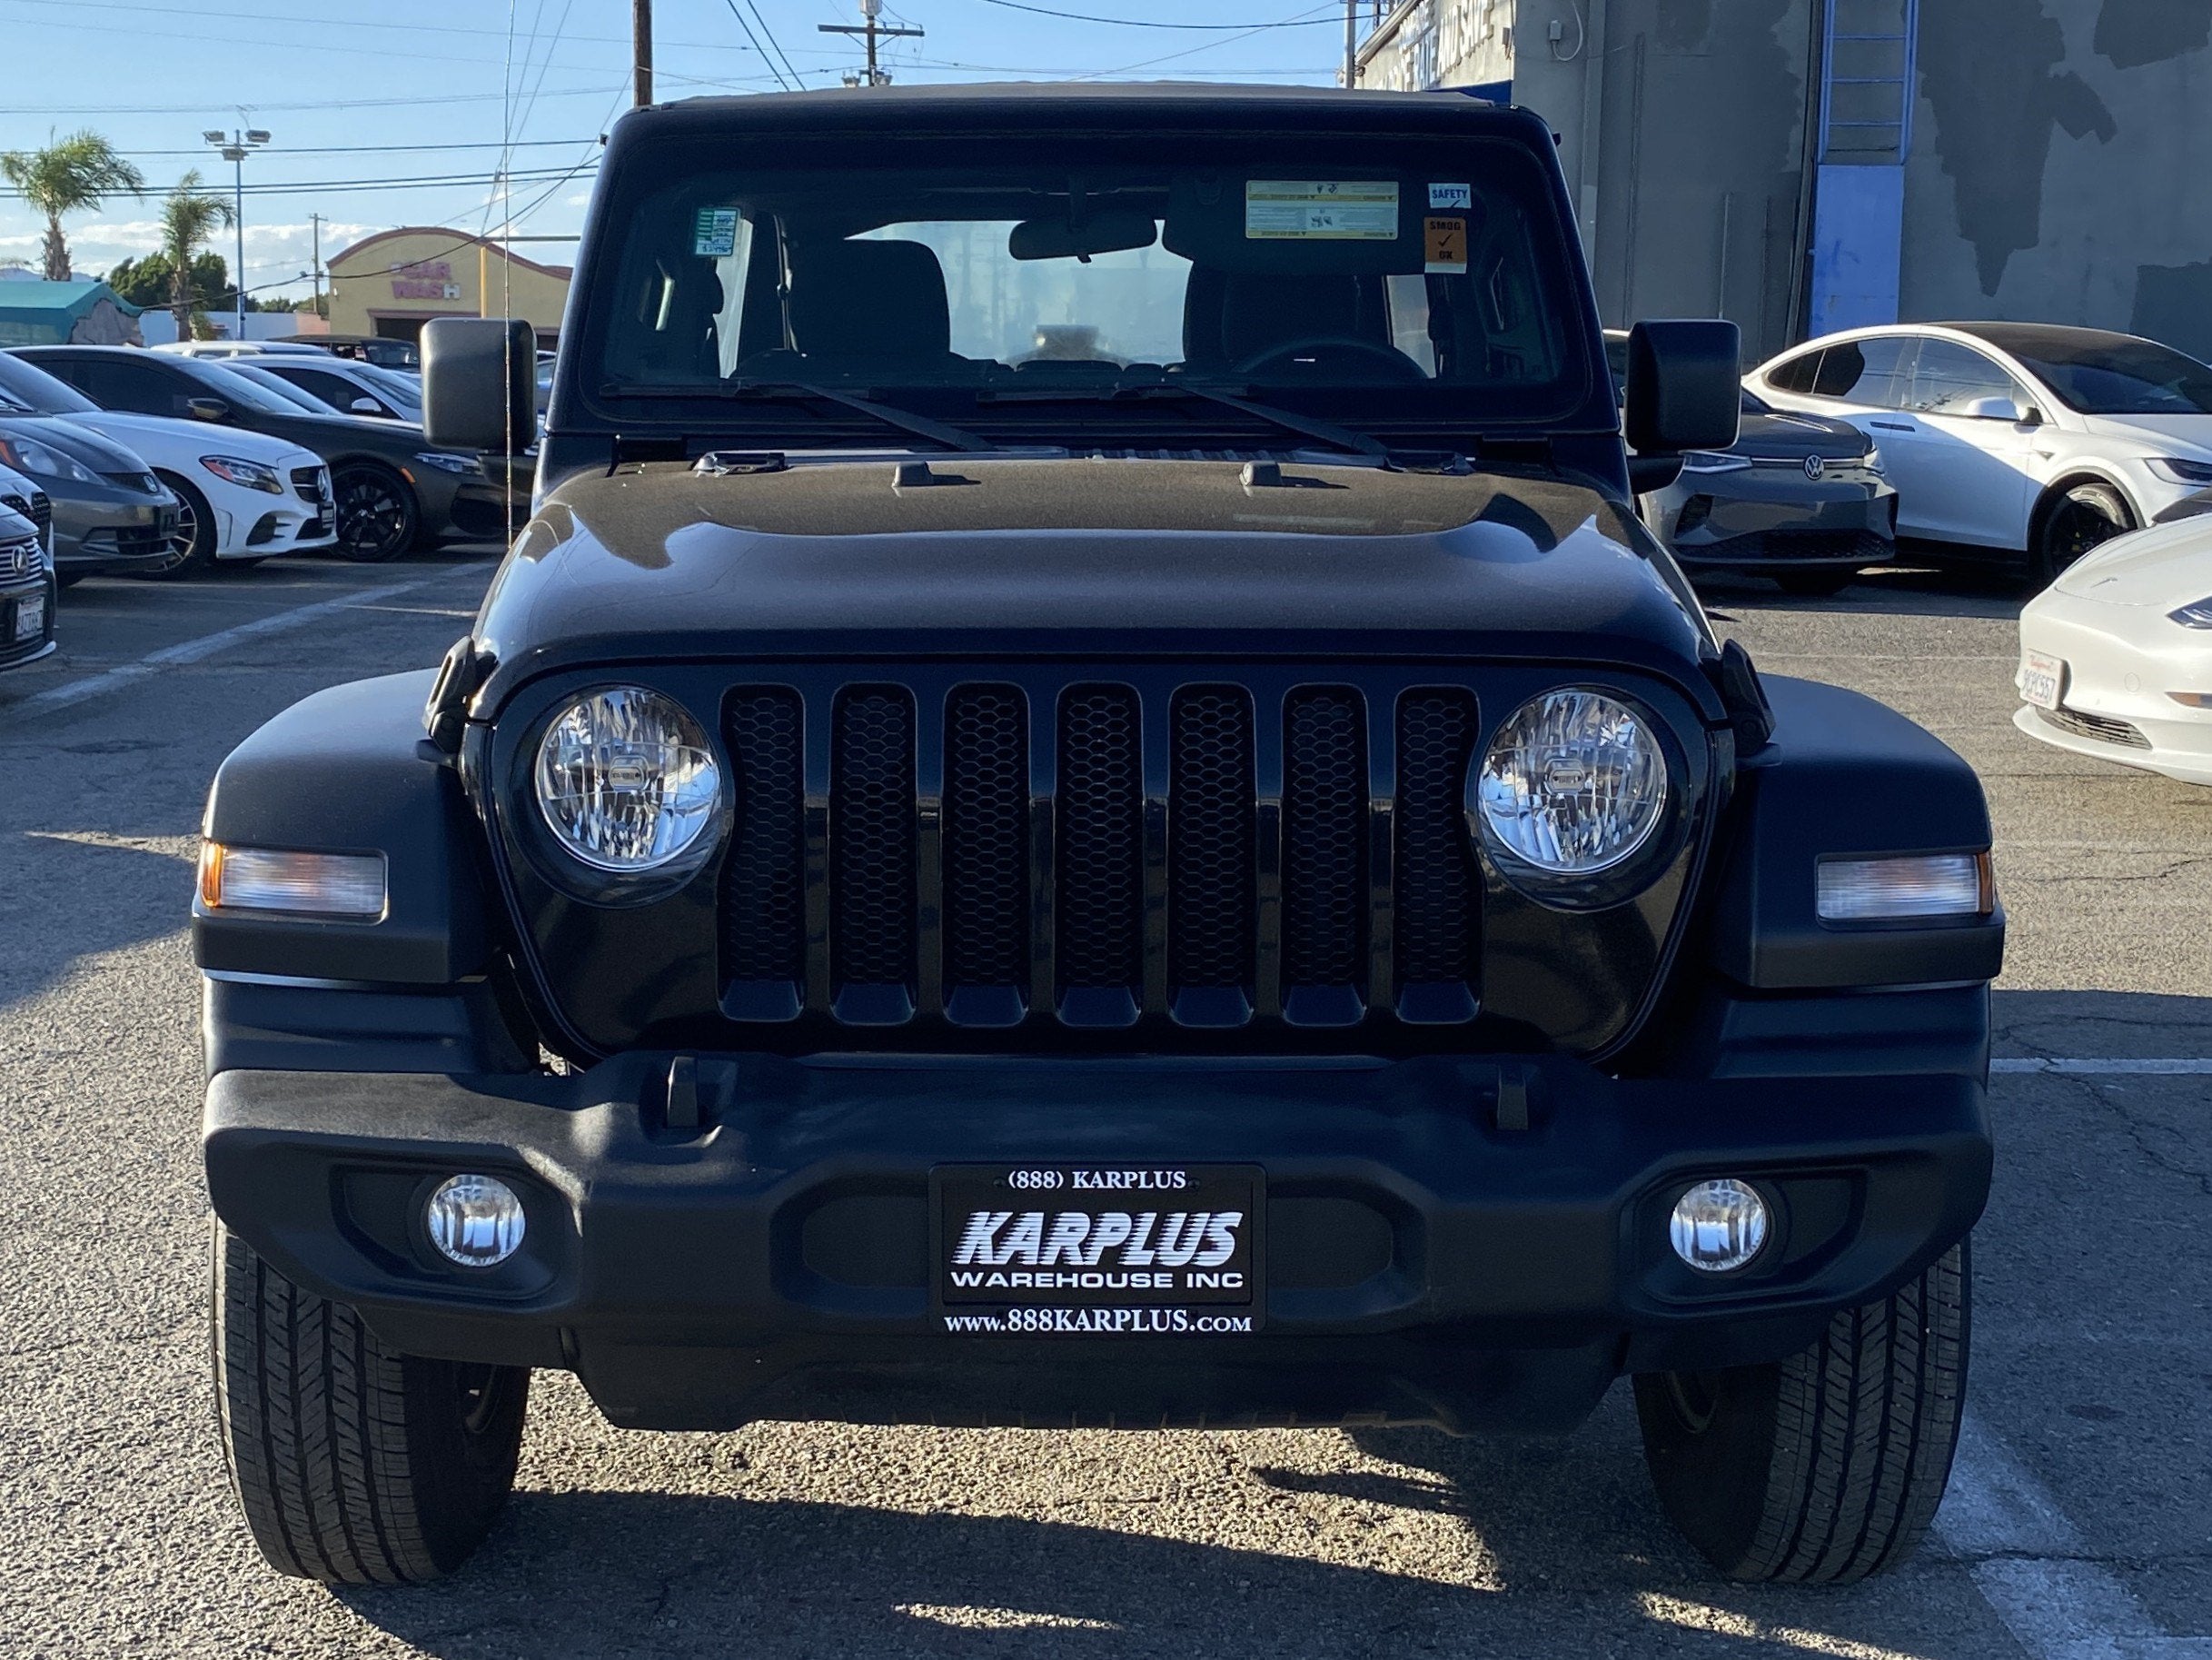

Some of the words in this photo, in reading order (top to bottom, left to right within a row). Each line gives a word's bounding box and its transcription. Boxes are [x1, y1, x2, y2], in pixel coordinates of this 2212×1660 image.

[1432, 188, 1468, 199] SAFETY
[1429, 221, 1462, 231] SMOG
[1438, 250, 1453, 260] OK
[1007, 1170, 1064, 1189] (888)
[1071, 1170, 1186, 1189] KARPLUS
[950, 1211, 1244, 1267] KARPLUS
[950, 1271, 1174, 1288] WAREHOUSE
[1186, 1272, 1244, 1288] INC
